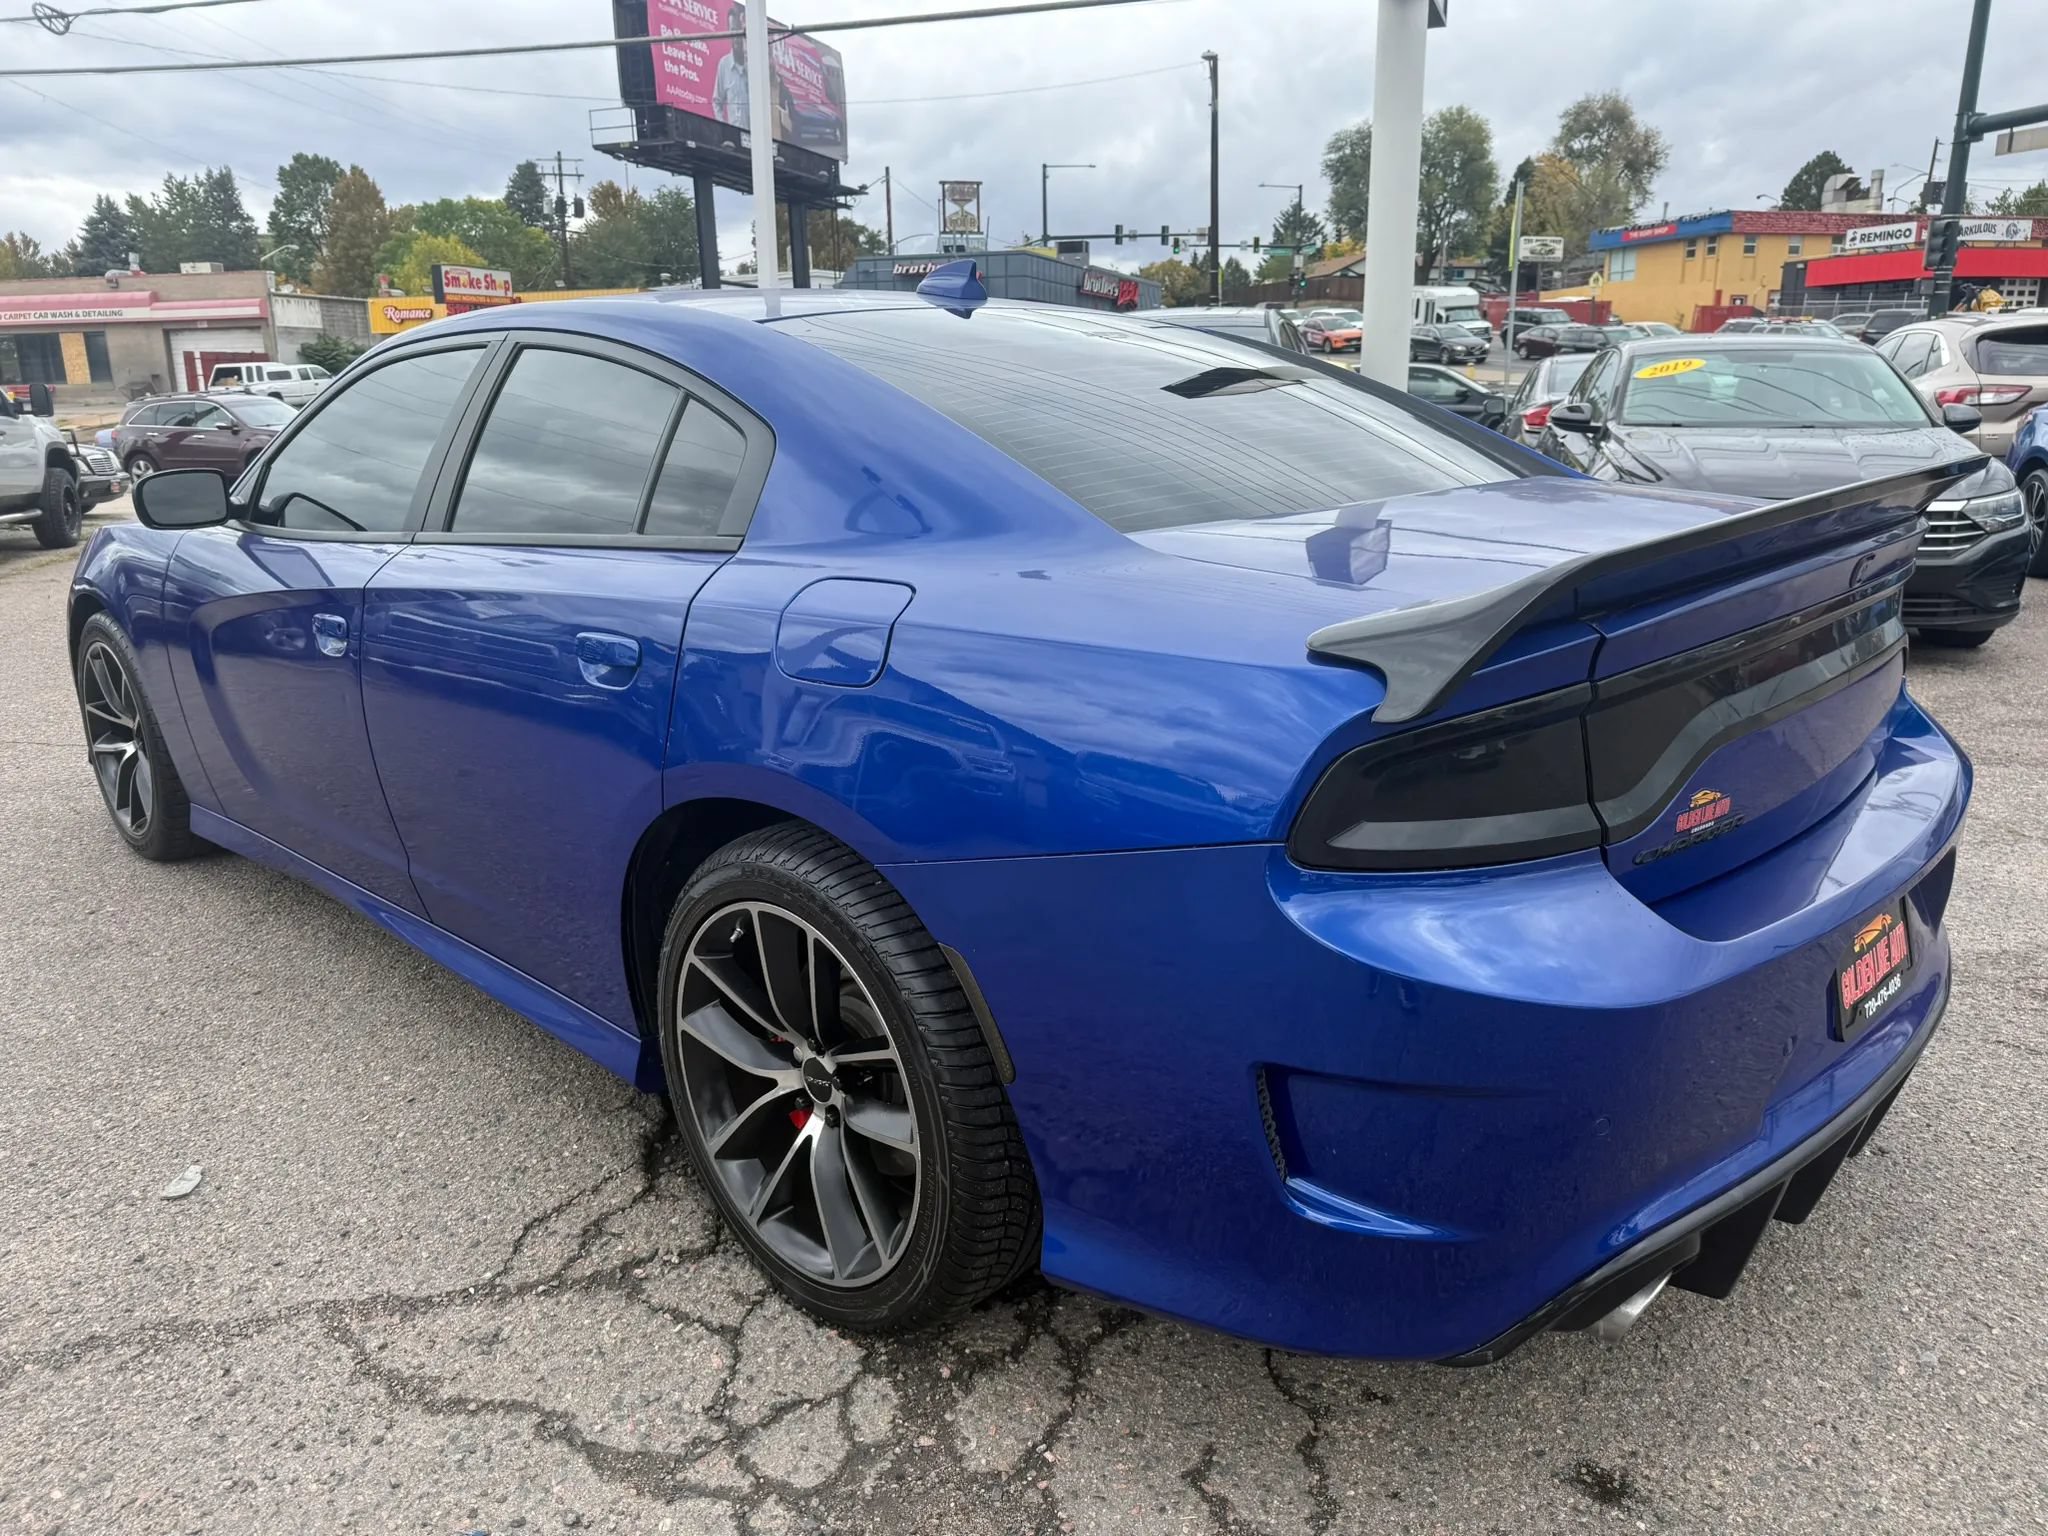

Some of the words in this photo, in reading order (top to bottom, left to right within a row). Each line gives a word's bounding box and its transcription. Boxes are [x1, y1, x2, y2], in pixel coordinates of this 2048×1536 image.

[684, 0, 718, 25] SERVICE
[662, 42, 686, 60] Leave
[694, 54, 703, 67] to
[664, 60, 679, 75] the
[680, 65, 700, 82] Pros.
[1859, 228, 1912, 243] REMINGO
[1959, 223, 1997, 237] ARKULOUS
[893, 263, 934, 274] broth
[50, 311, 73, 319] WASH
[82, 310, 123, 318] DETAILING
[384, 305, 432, 323] Romance
[1648, 360, 1692, 376] 2019
